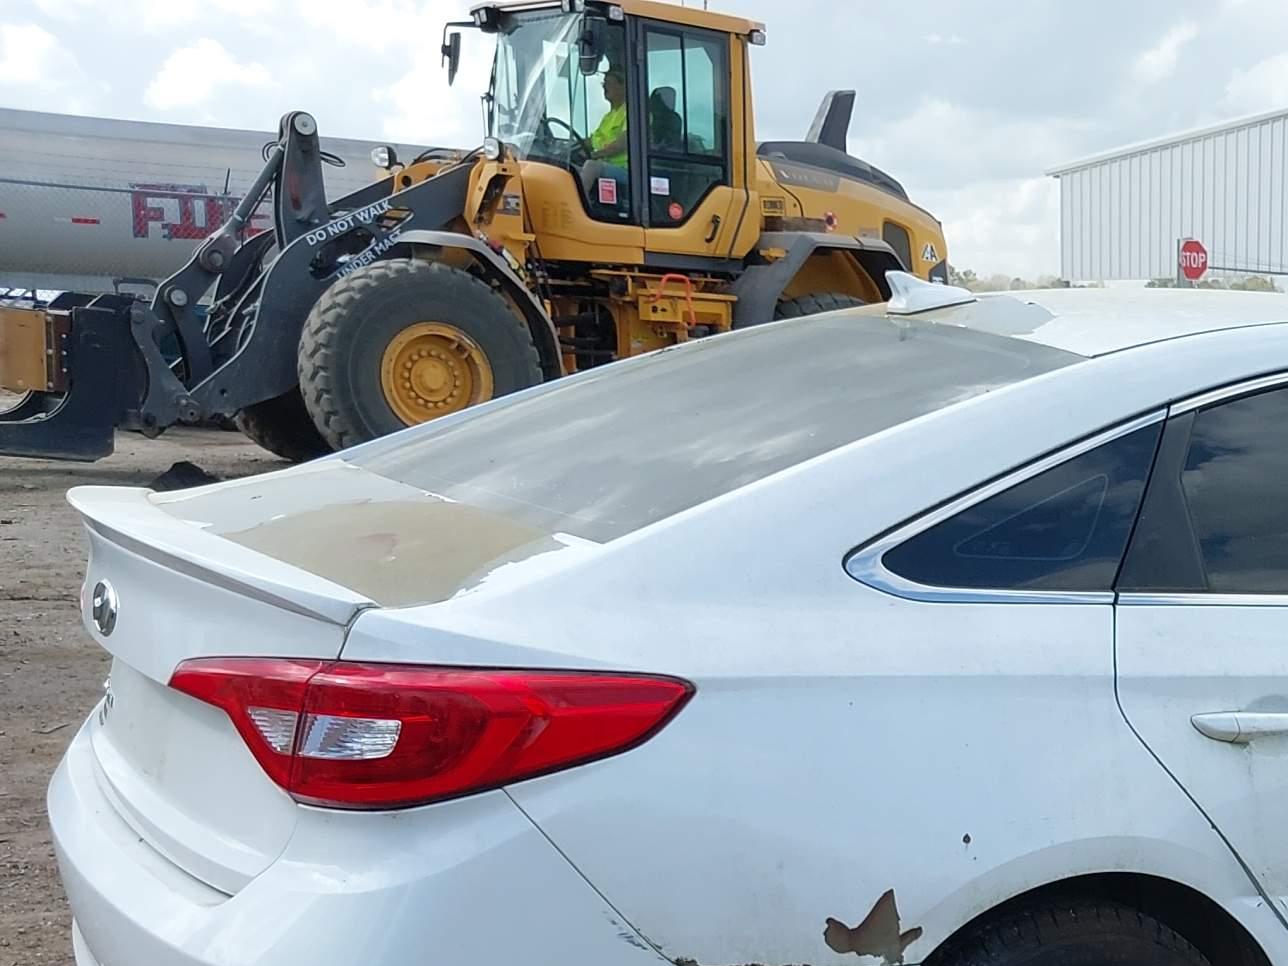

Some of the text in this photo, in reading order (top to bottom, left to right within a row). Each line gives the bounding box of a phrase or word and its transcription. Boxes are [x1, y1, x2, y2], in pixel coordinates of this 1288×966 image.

[305, 200, 393, 246] DO NOT WALK
[335, 251, 376, 279] UNDER
[1180, 251, 1206, 268] STOP
